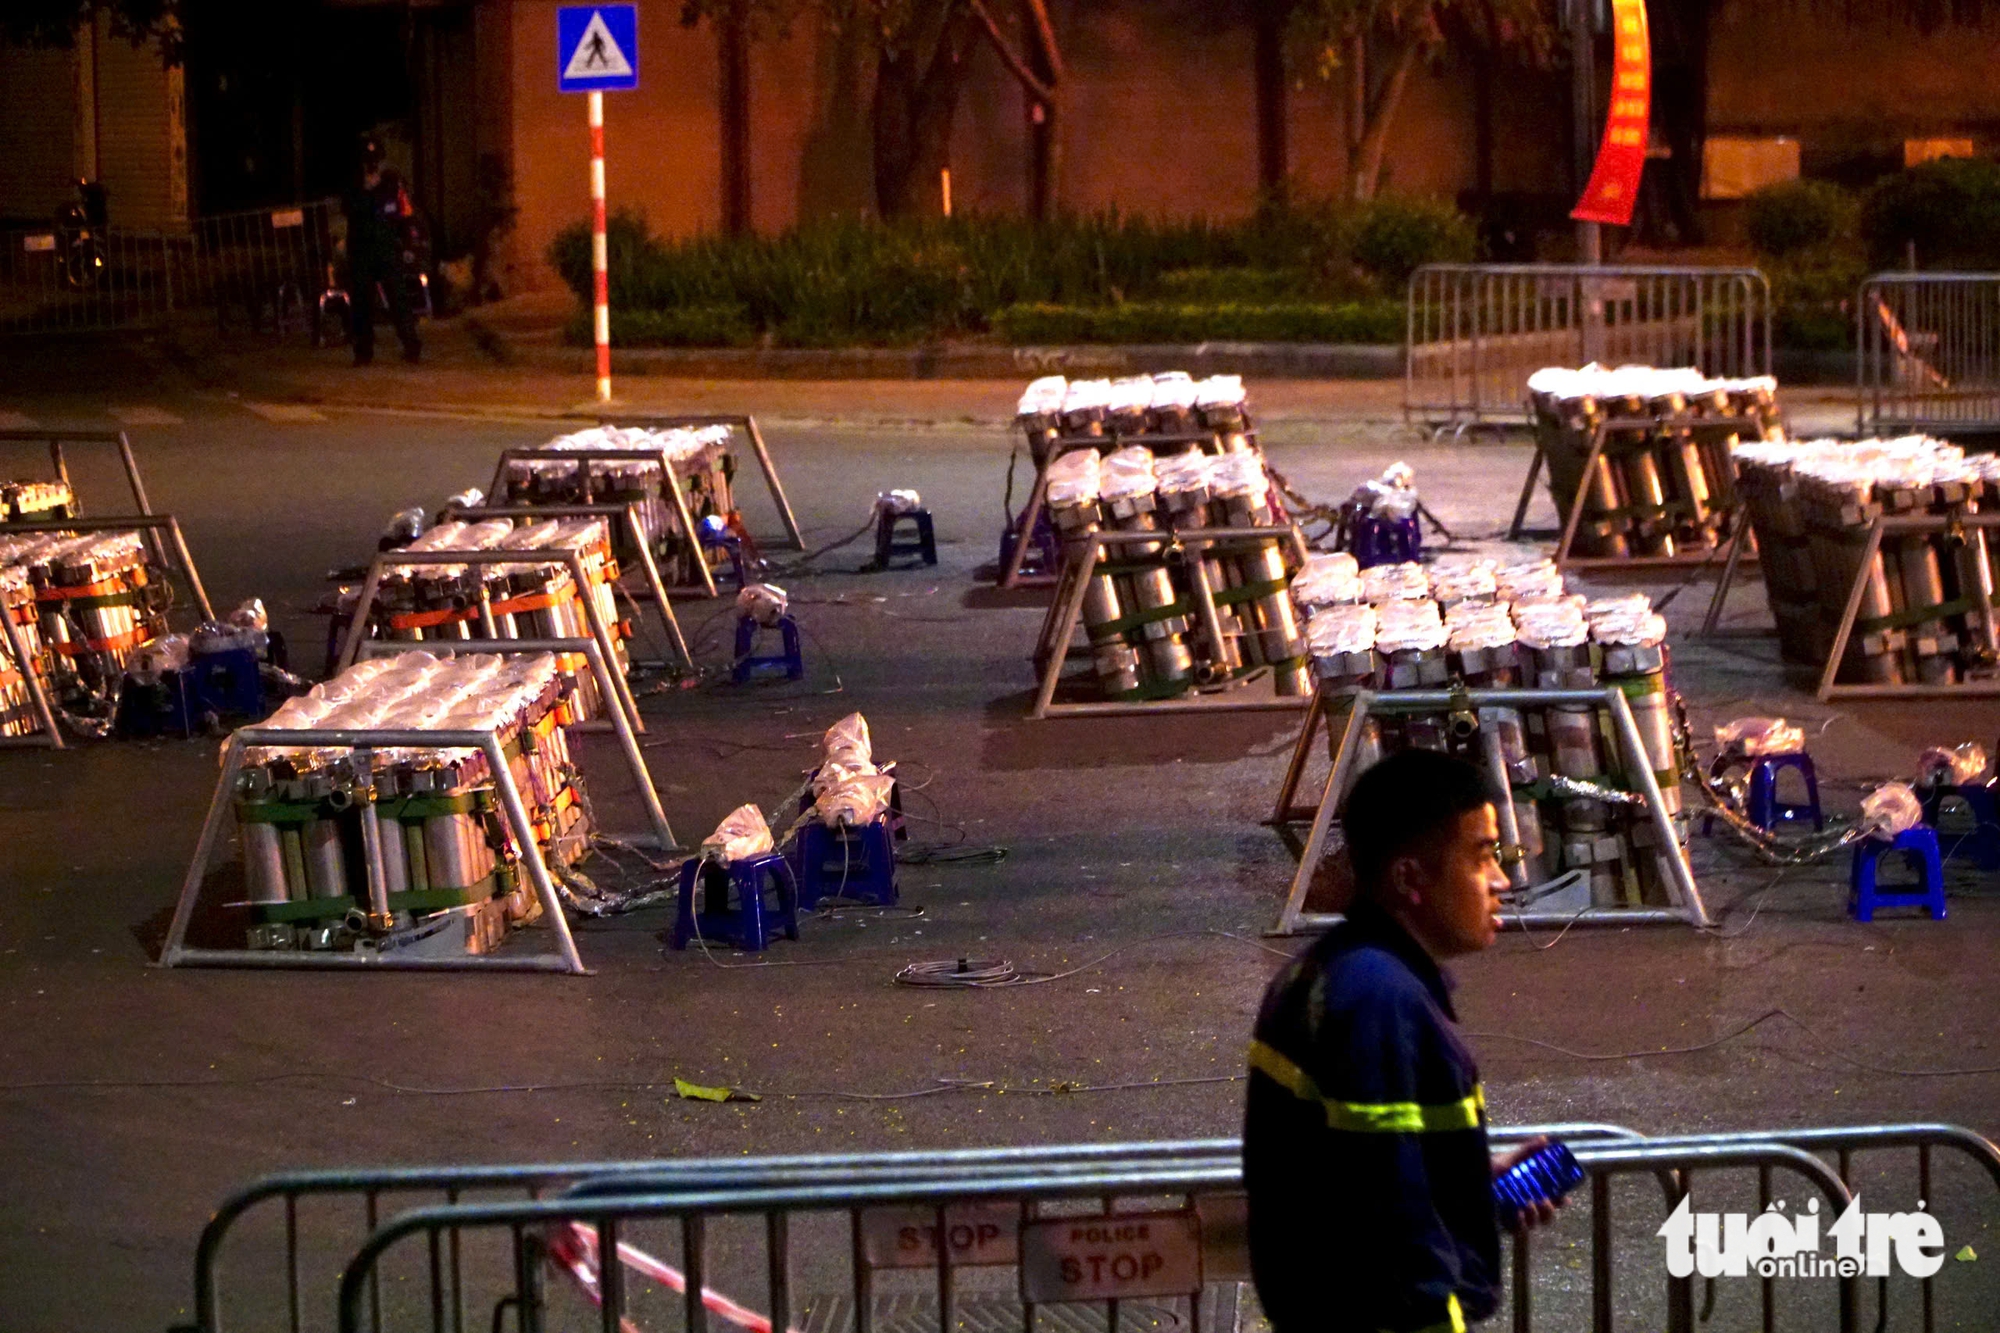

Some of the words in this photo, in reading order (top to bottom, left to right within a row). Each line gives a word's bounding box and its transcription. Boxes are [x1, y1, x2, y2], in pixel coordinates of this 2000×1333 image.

[898, 1223, 1000, 1251] STOP
[1070, 1224, 1150, 1244] POLICE
[1060, 1251, 1165, 1284] STOP
